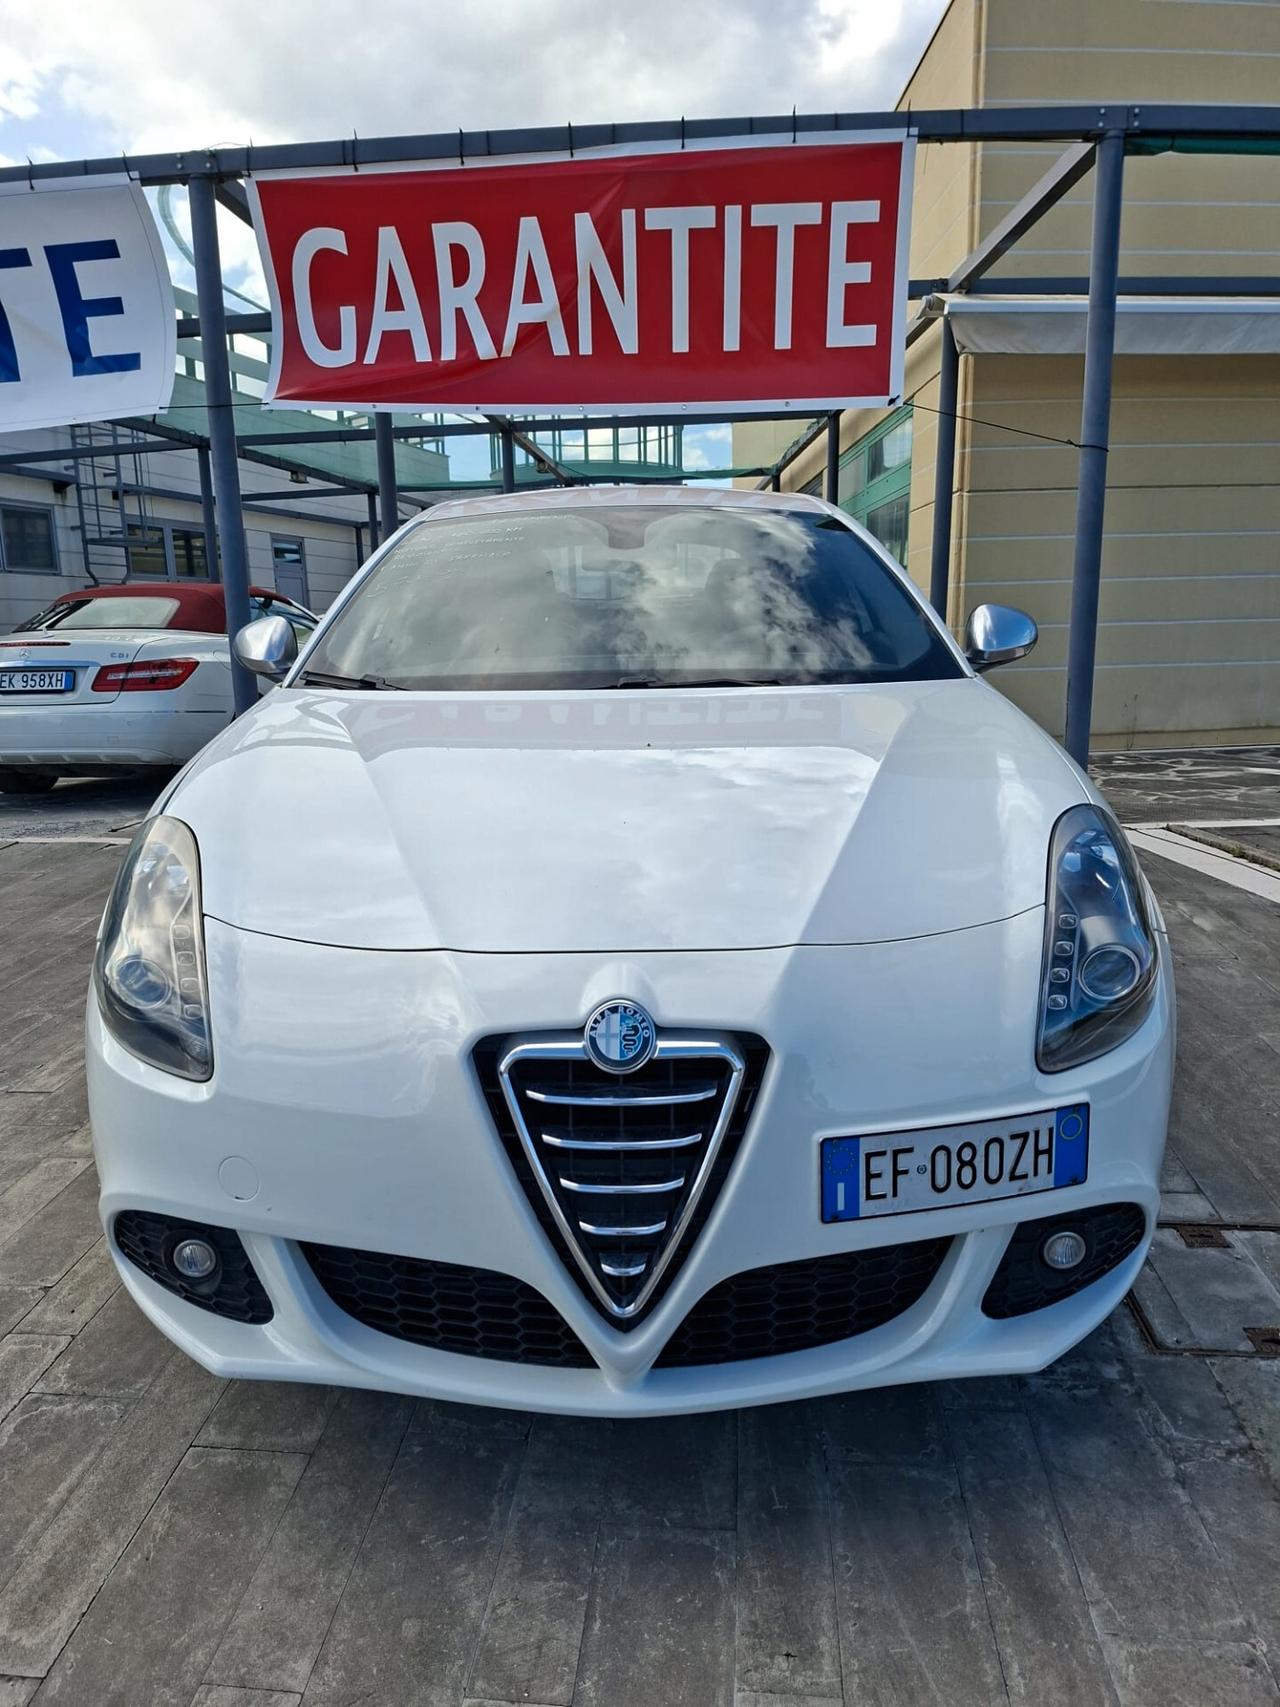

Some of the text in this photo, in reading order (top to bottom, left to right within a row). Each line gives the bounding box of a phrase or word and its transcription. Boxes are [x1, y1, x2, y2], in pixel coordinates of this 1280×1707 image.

[291, 200, 881, 369] GARANTITE
[0, 672, 64, 689] EK 958XH
[589, 1005, 650, 1038] ALFA ROMEO
[864, 1127, 1055, 1201] EF 080ZH
